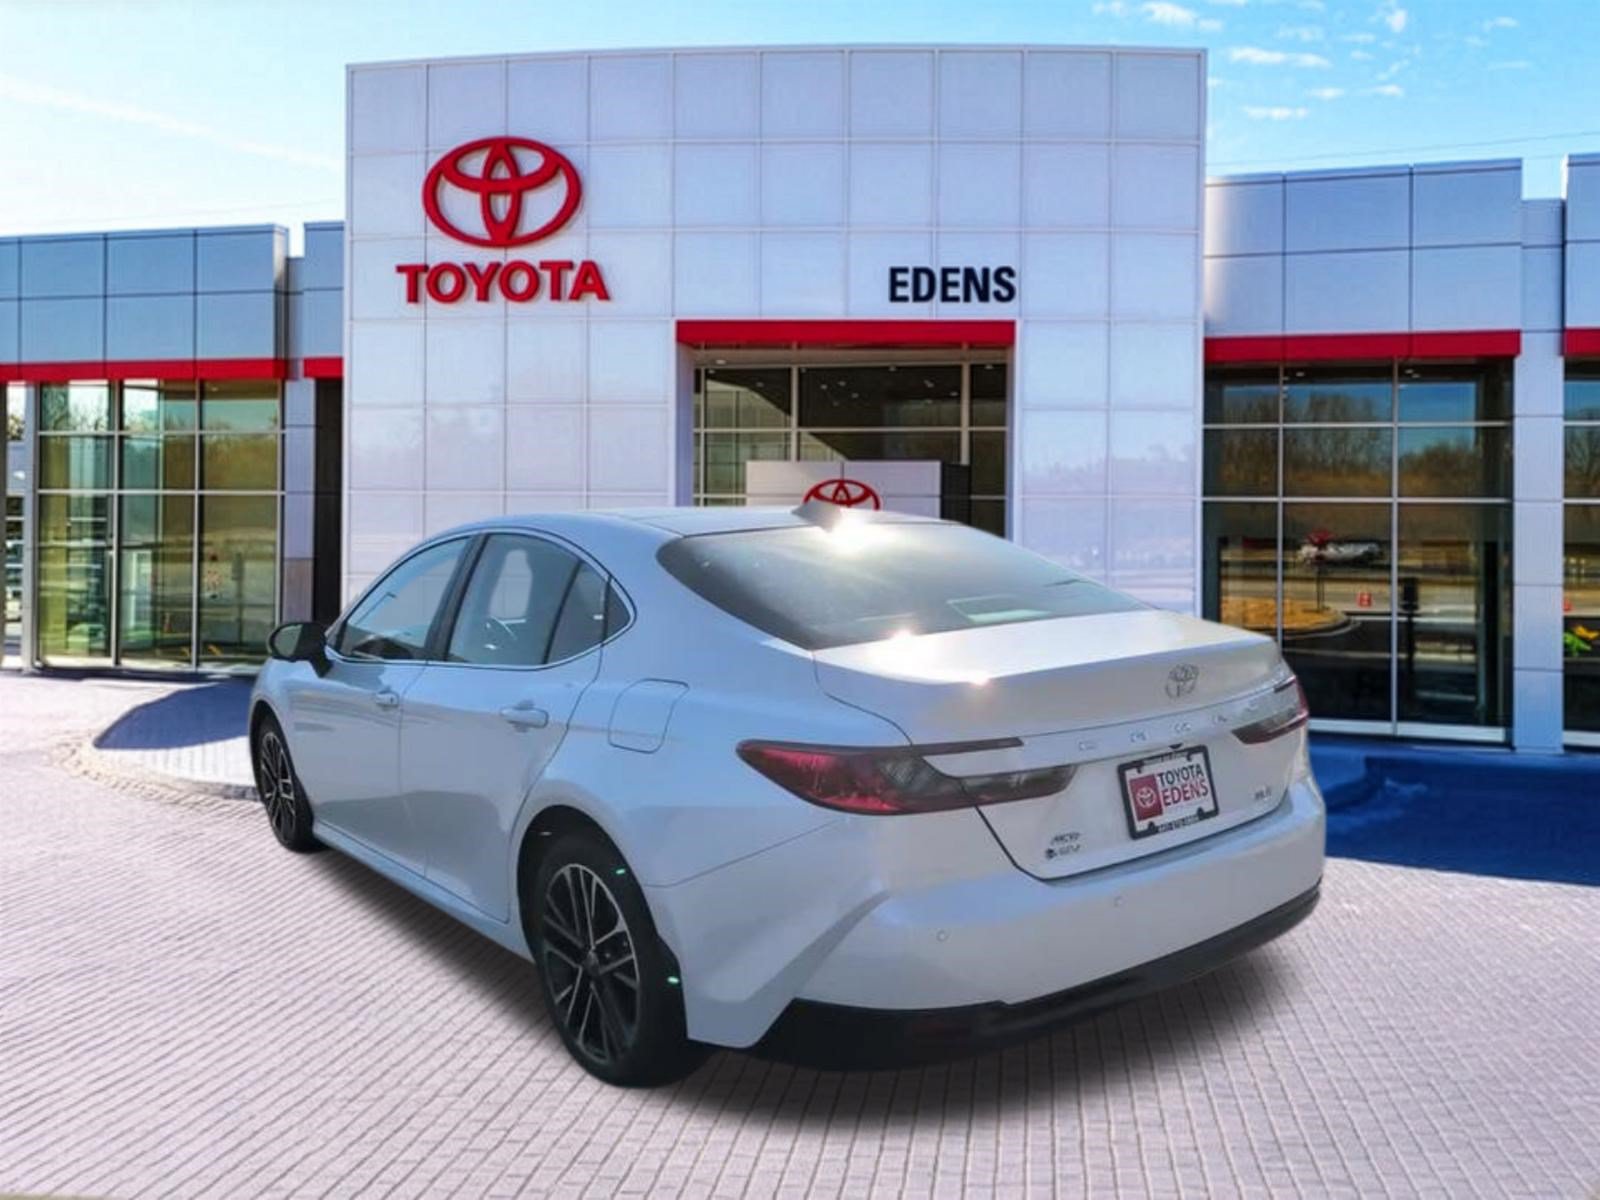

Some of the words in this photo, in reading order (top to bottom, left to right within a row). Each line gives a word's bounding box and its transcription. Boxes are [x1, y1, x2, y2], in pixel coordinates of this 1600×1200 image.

[396, 260, 610, 304] TOYOTA
[889, 266, 1016, 303] EDENS
[1157, 763, 1204, 787] TOYOTA
[1162, 779, 1209, 806] EDENS
